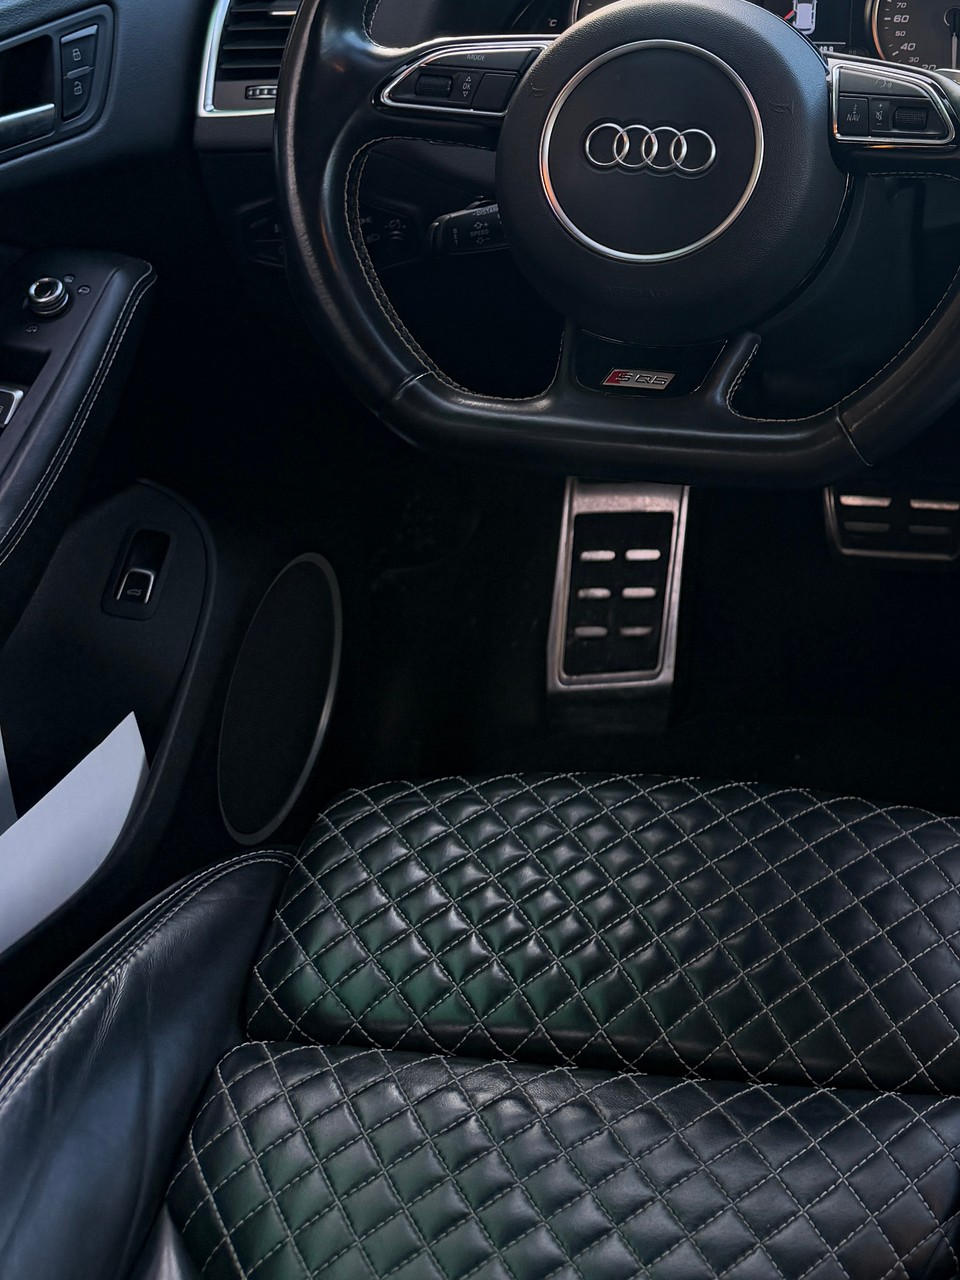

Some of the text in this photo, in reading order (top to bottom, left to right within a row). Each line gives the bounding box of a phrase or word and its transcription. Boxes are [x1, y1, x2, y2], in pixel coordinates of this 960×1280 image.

[893, 14, 910, 23] 60
[900, 42, 916, 51] 40
[466, 53, 486, 61] MODE
[462, 82, 471, 90] OK
[846, 113, 861, 122] NAV
[470, 229, 490, 237] SPEED
